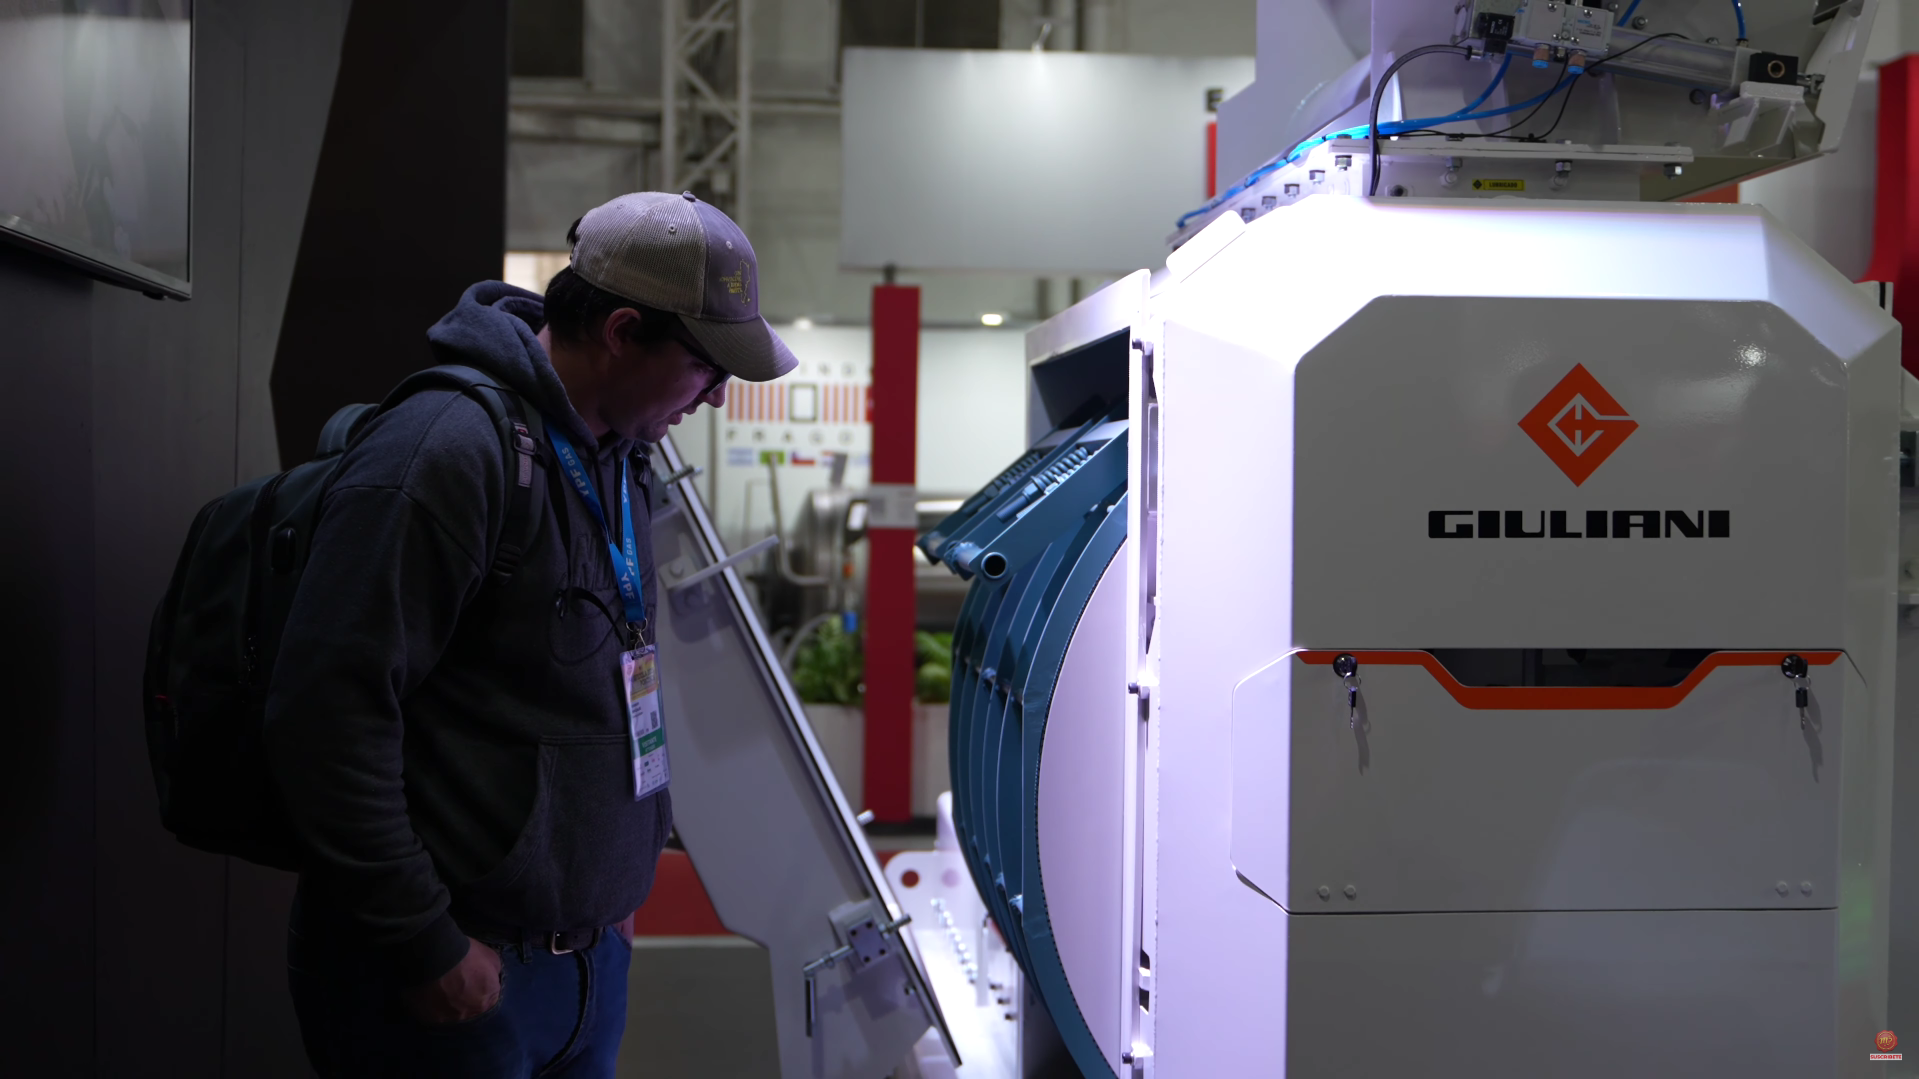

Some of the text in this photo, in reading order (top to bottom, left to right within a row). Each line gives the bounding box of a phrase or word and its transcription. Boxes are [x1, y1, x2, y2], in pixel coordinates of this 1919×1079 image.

[561, 446, 590, 498] YPF GAS
[1428, 510, 1730, 539] GIULIANI
[625, 537, 633, 556] GAS
[621, 571, 635, 600] YPF
